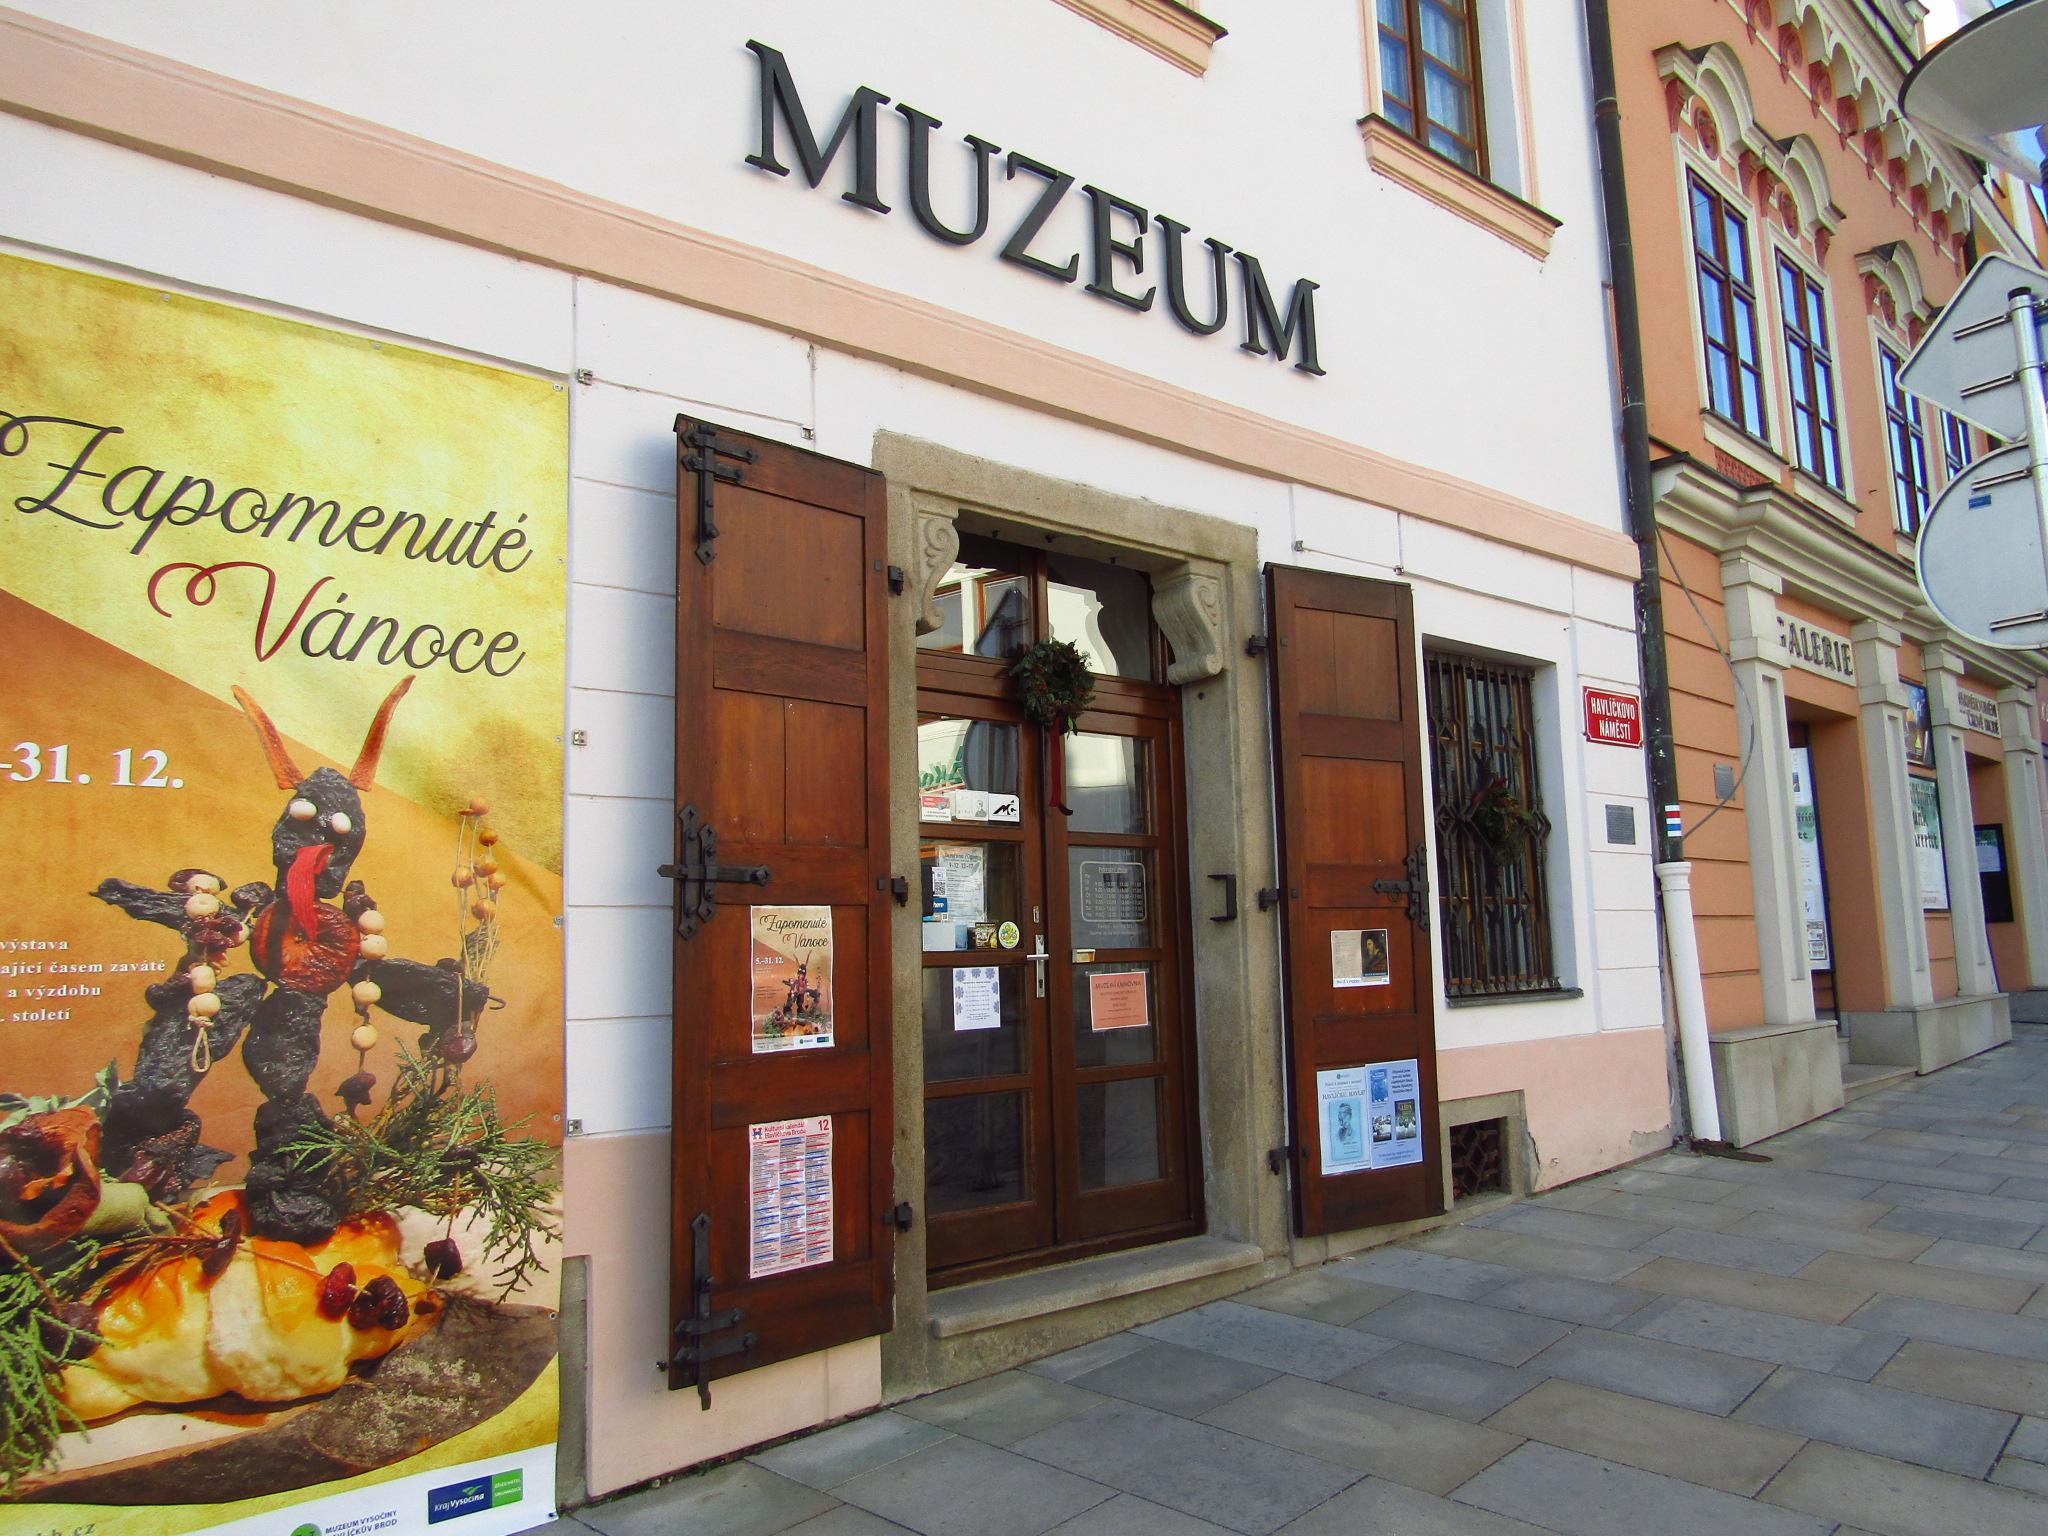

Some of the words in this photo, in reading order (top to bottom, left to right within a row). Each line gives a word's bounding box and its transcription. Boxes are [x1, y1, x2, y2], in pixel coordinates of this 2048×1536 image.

[744, 38, 1327, 377] MUZEUM
[0, 410, 534, 574] Zapomenuté
[147, 560, 527, 678] Vánoce
[1591, 697, 1635, 720] HAVLÍČKOVO
[1599, 717, 1631, 741] NÁMĚSTÍ
[111, 748, 184, 789] 12.
[760, 914, 828, 934] Zapomenuté
[0, 938, 69, 953] výstava
[783, 932, 830, 949] Vánoce
[50, 961, 103, 973] časem
[110, 959, 166, 972] zaváté
[8, 988, 17, 998] a
[26, 984, 101, 1000] výzdobu
[13, 1007, 72, 1022] století
[818, 1119, 829, 1131] 12
[325, 1519, 359, 1534] MUZEUM
[374, 1518, 397, 1530] BROD
